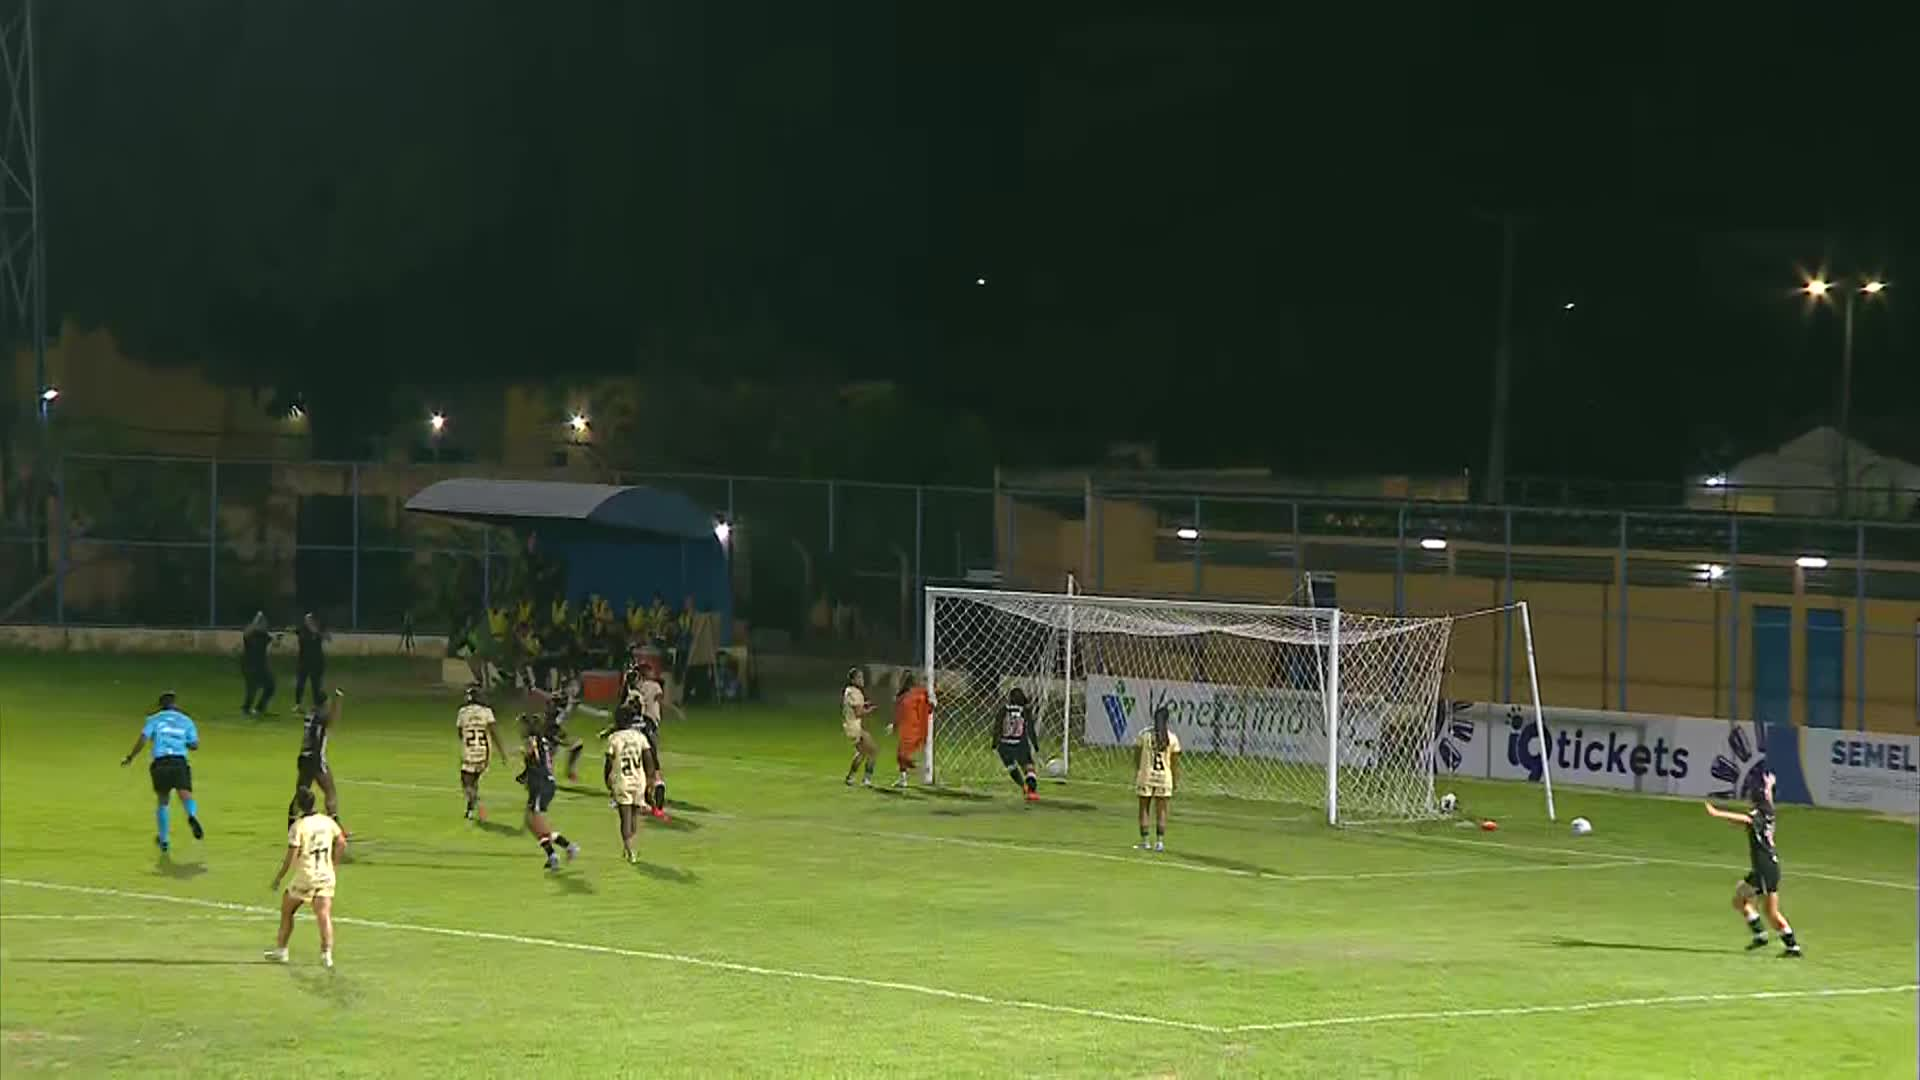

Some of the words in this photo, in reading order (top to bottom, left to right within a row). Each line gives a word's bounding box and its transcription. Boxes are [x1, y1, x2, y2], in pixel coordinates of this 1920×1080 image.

[465, 729, 488, 747] 23
[1831, 740, 1917, 772] SEMEL
[621, 757, 641, 777] 24
